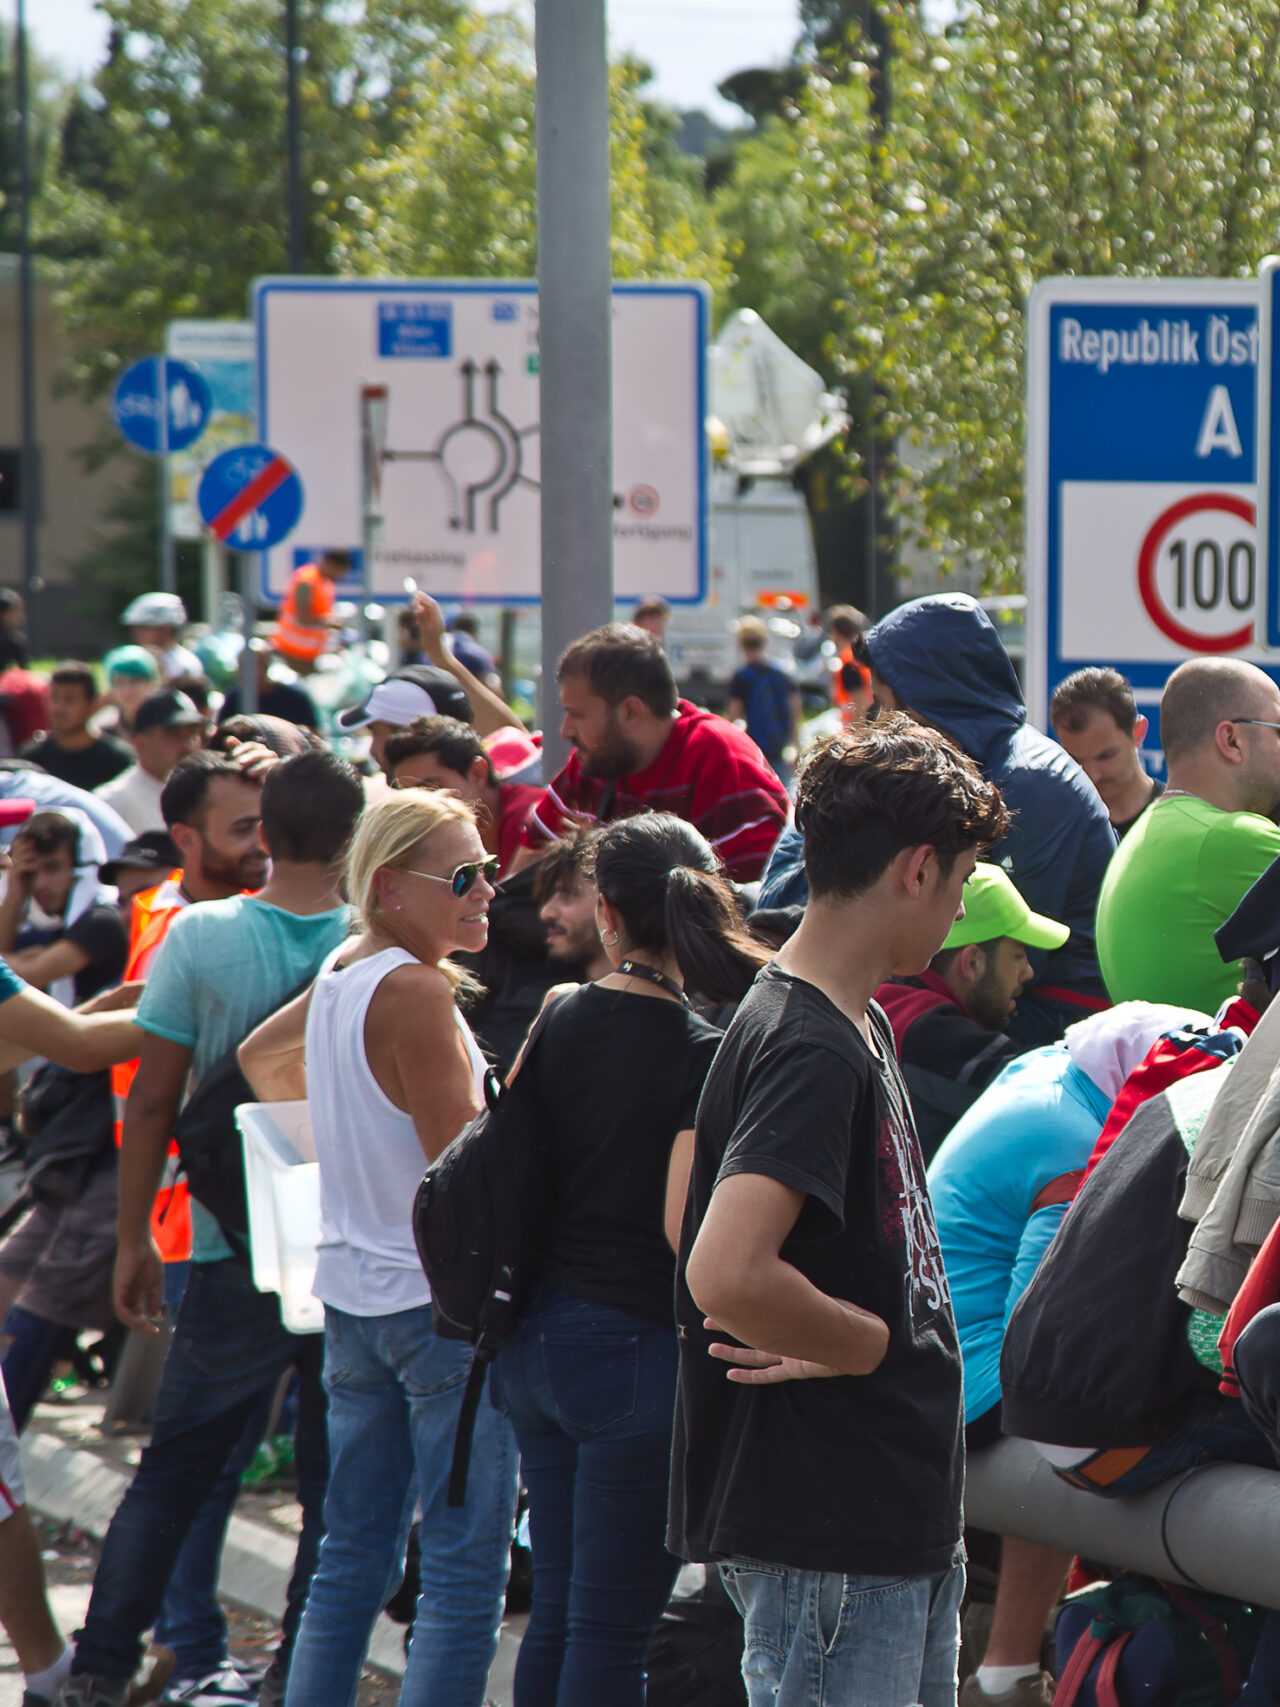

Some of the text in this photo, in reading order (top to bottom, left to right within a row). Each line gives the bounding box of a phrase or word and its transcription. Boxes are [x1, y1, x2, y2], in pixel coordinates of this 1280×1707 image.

[1060, 314, 1259, 374] Republik Öst
[1196, 384, 1243, 458] A
[1169, 538, 1257, 612] 100
